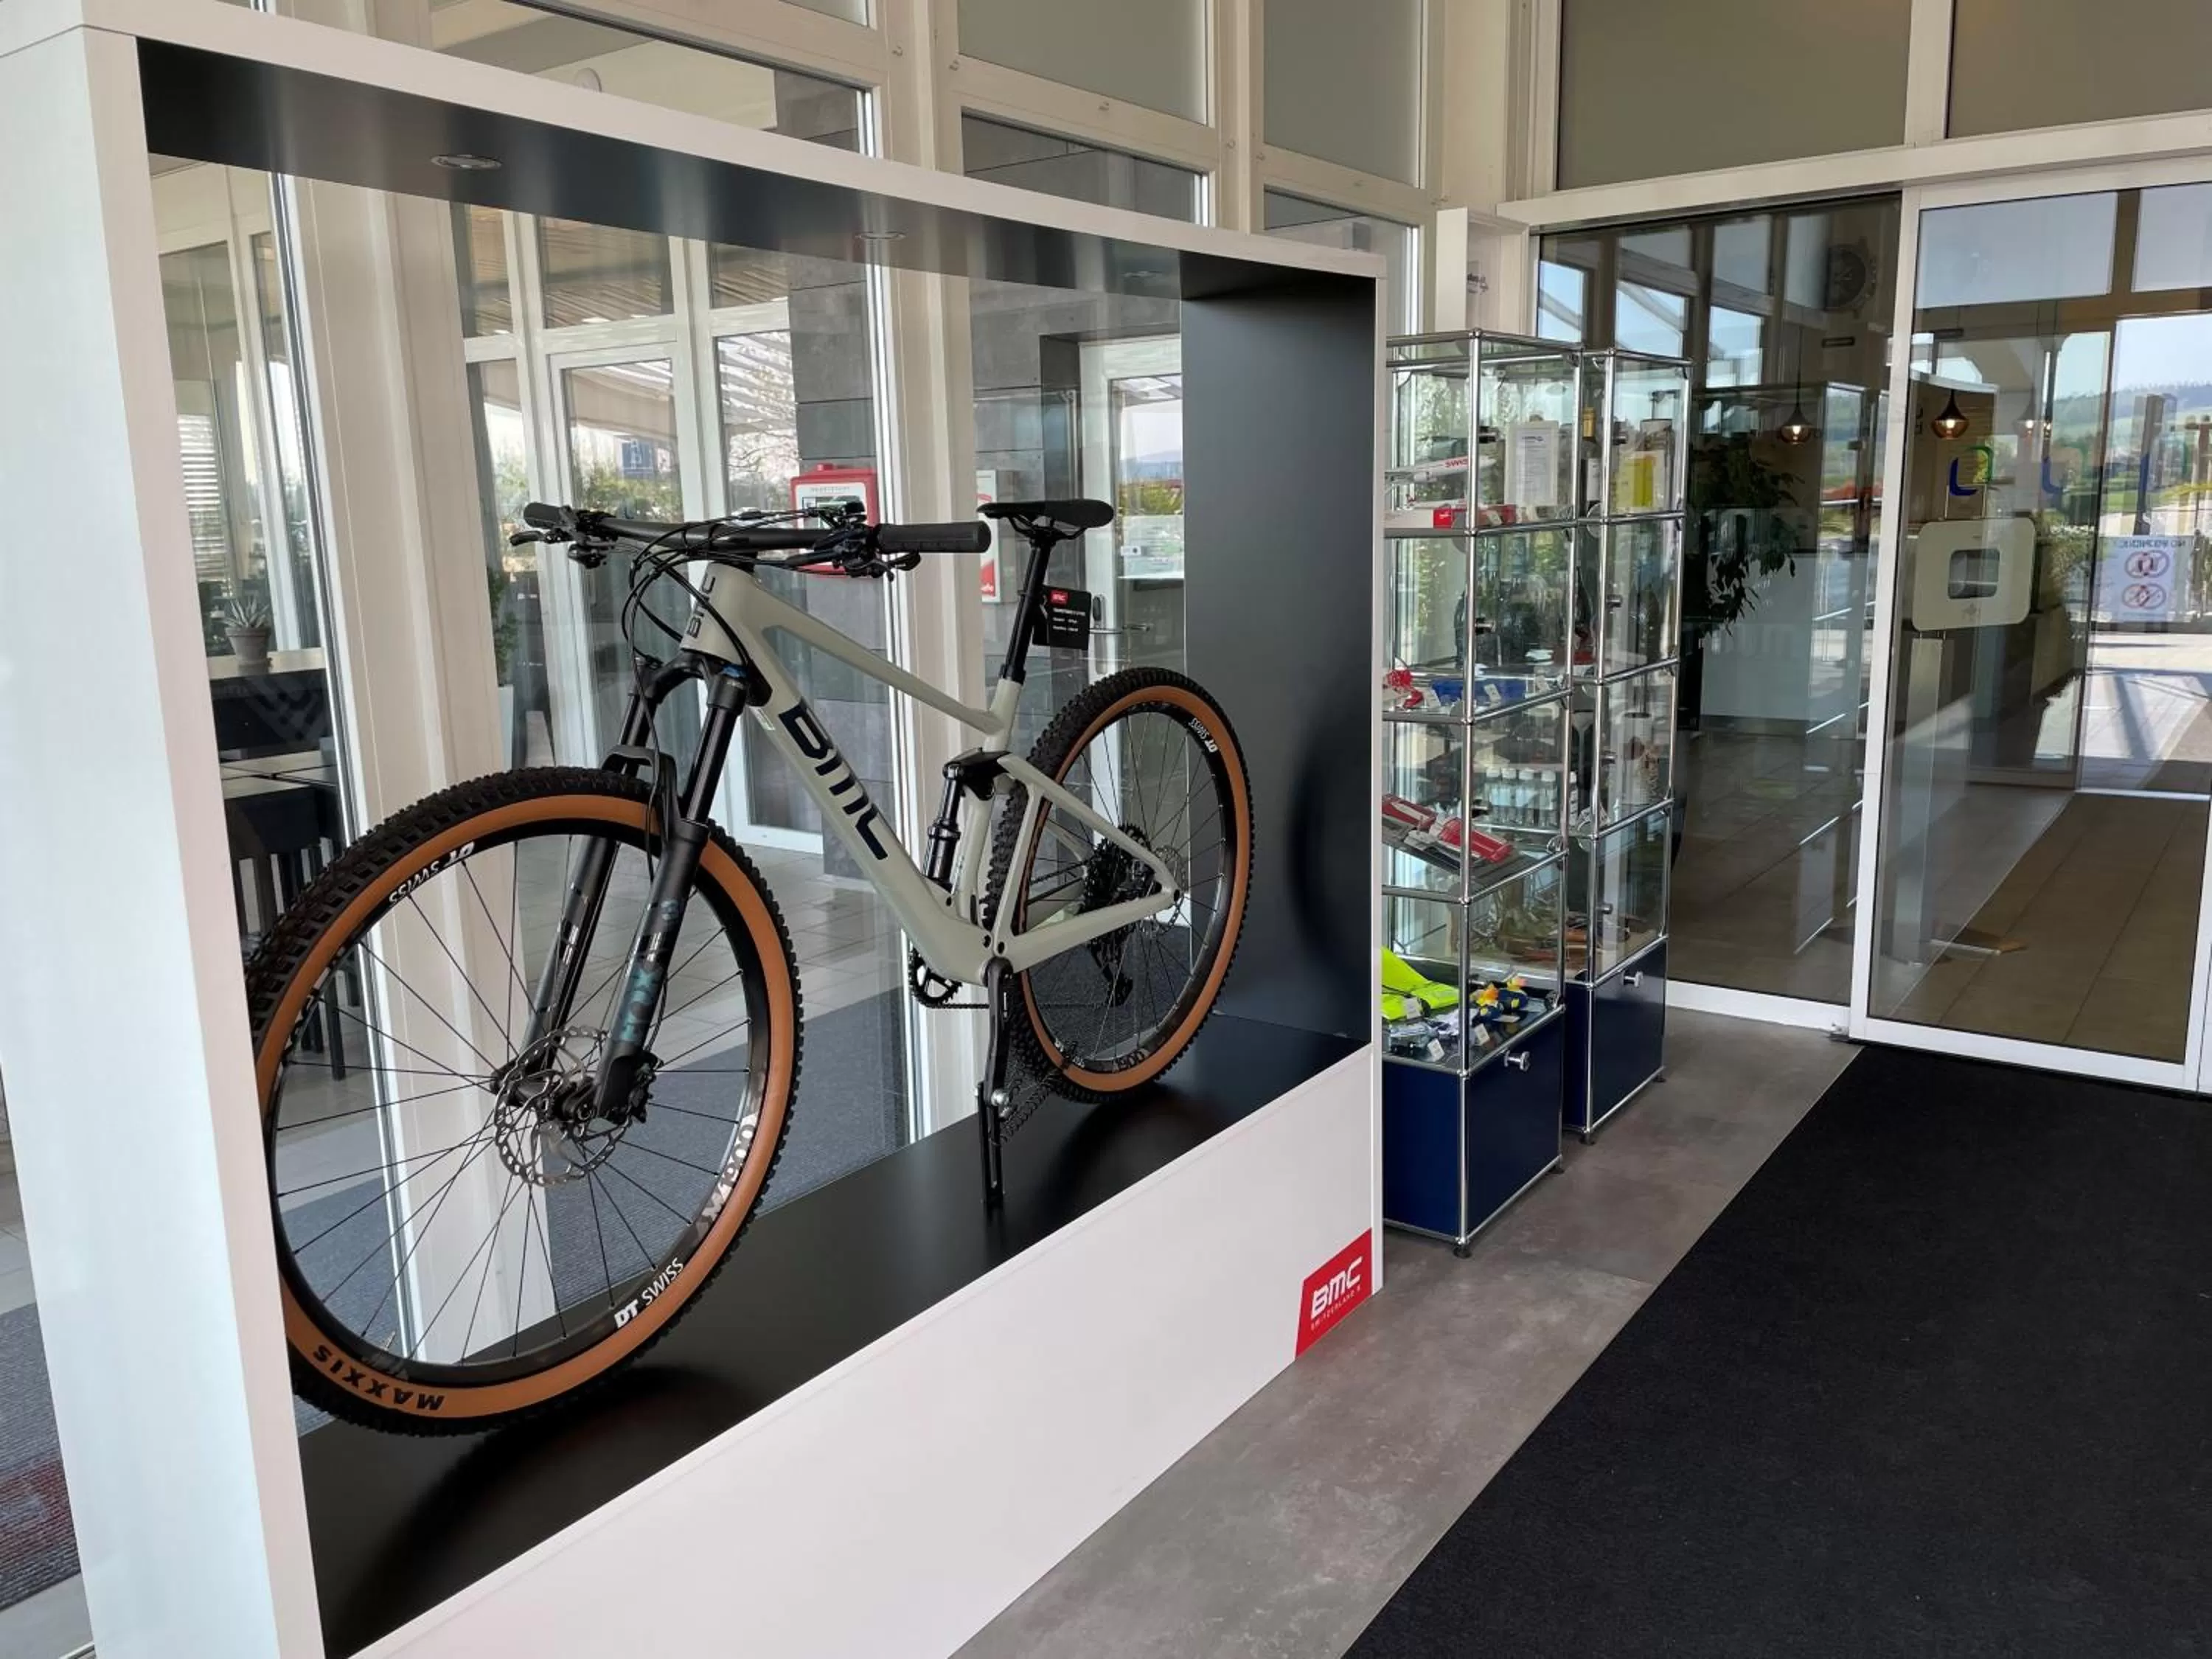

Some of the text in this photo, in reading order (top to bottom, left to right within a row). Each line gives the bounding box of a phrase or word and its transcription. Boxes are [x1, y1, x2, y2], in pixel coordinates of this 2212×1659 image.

[1188, 717, 1219, 753] DT SWISS
[389, 841, 475, 908] DT SWISS
[613, 1257, 684, 1328] DT SWISS
[1310, 1256, 1363, 1320] BMC
[313, 1344, 445, 1411] MAXXIS
